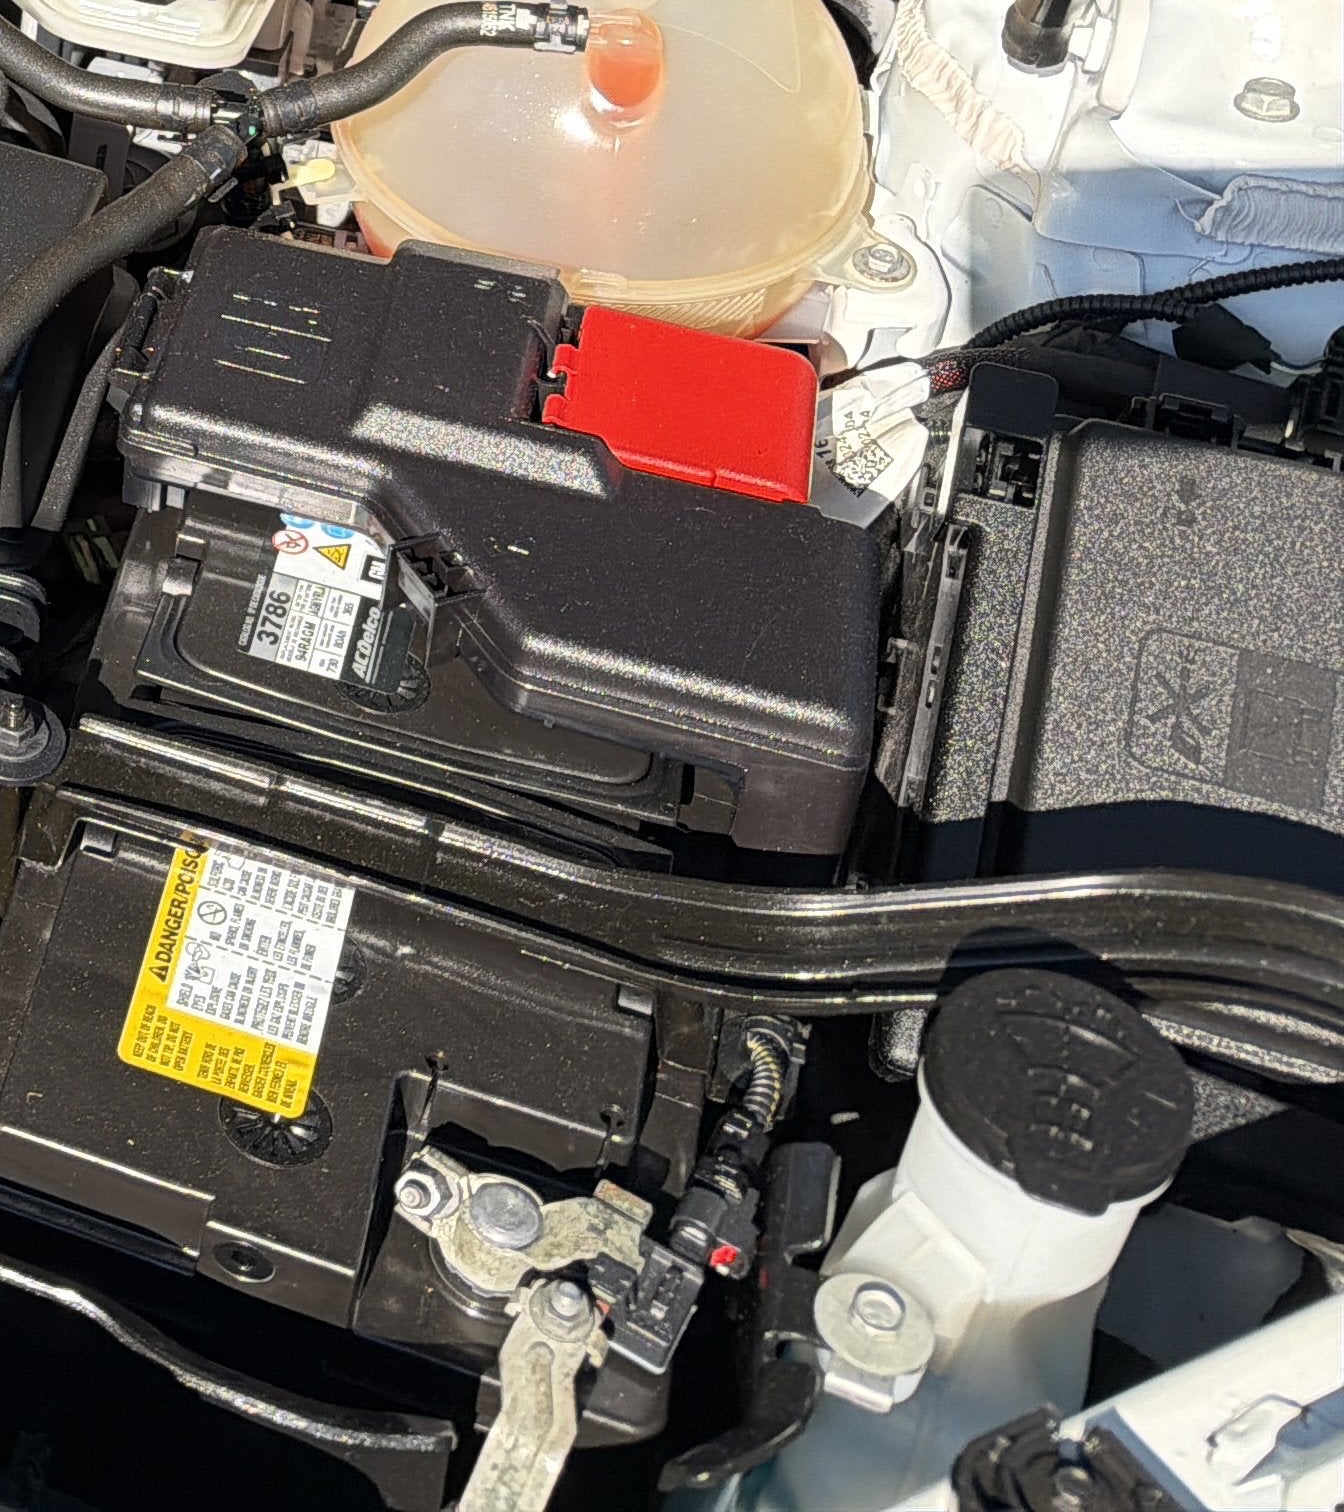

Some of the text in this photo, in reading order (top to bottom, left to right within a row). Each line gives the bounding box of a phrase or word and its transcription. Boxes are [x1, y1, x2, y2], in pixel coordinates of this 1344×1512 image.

[256, 589, 291, 646] 3786
[351, 605, 381, 680] ACDelco
[154, 848, 202, 965] DANGER/POISO
